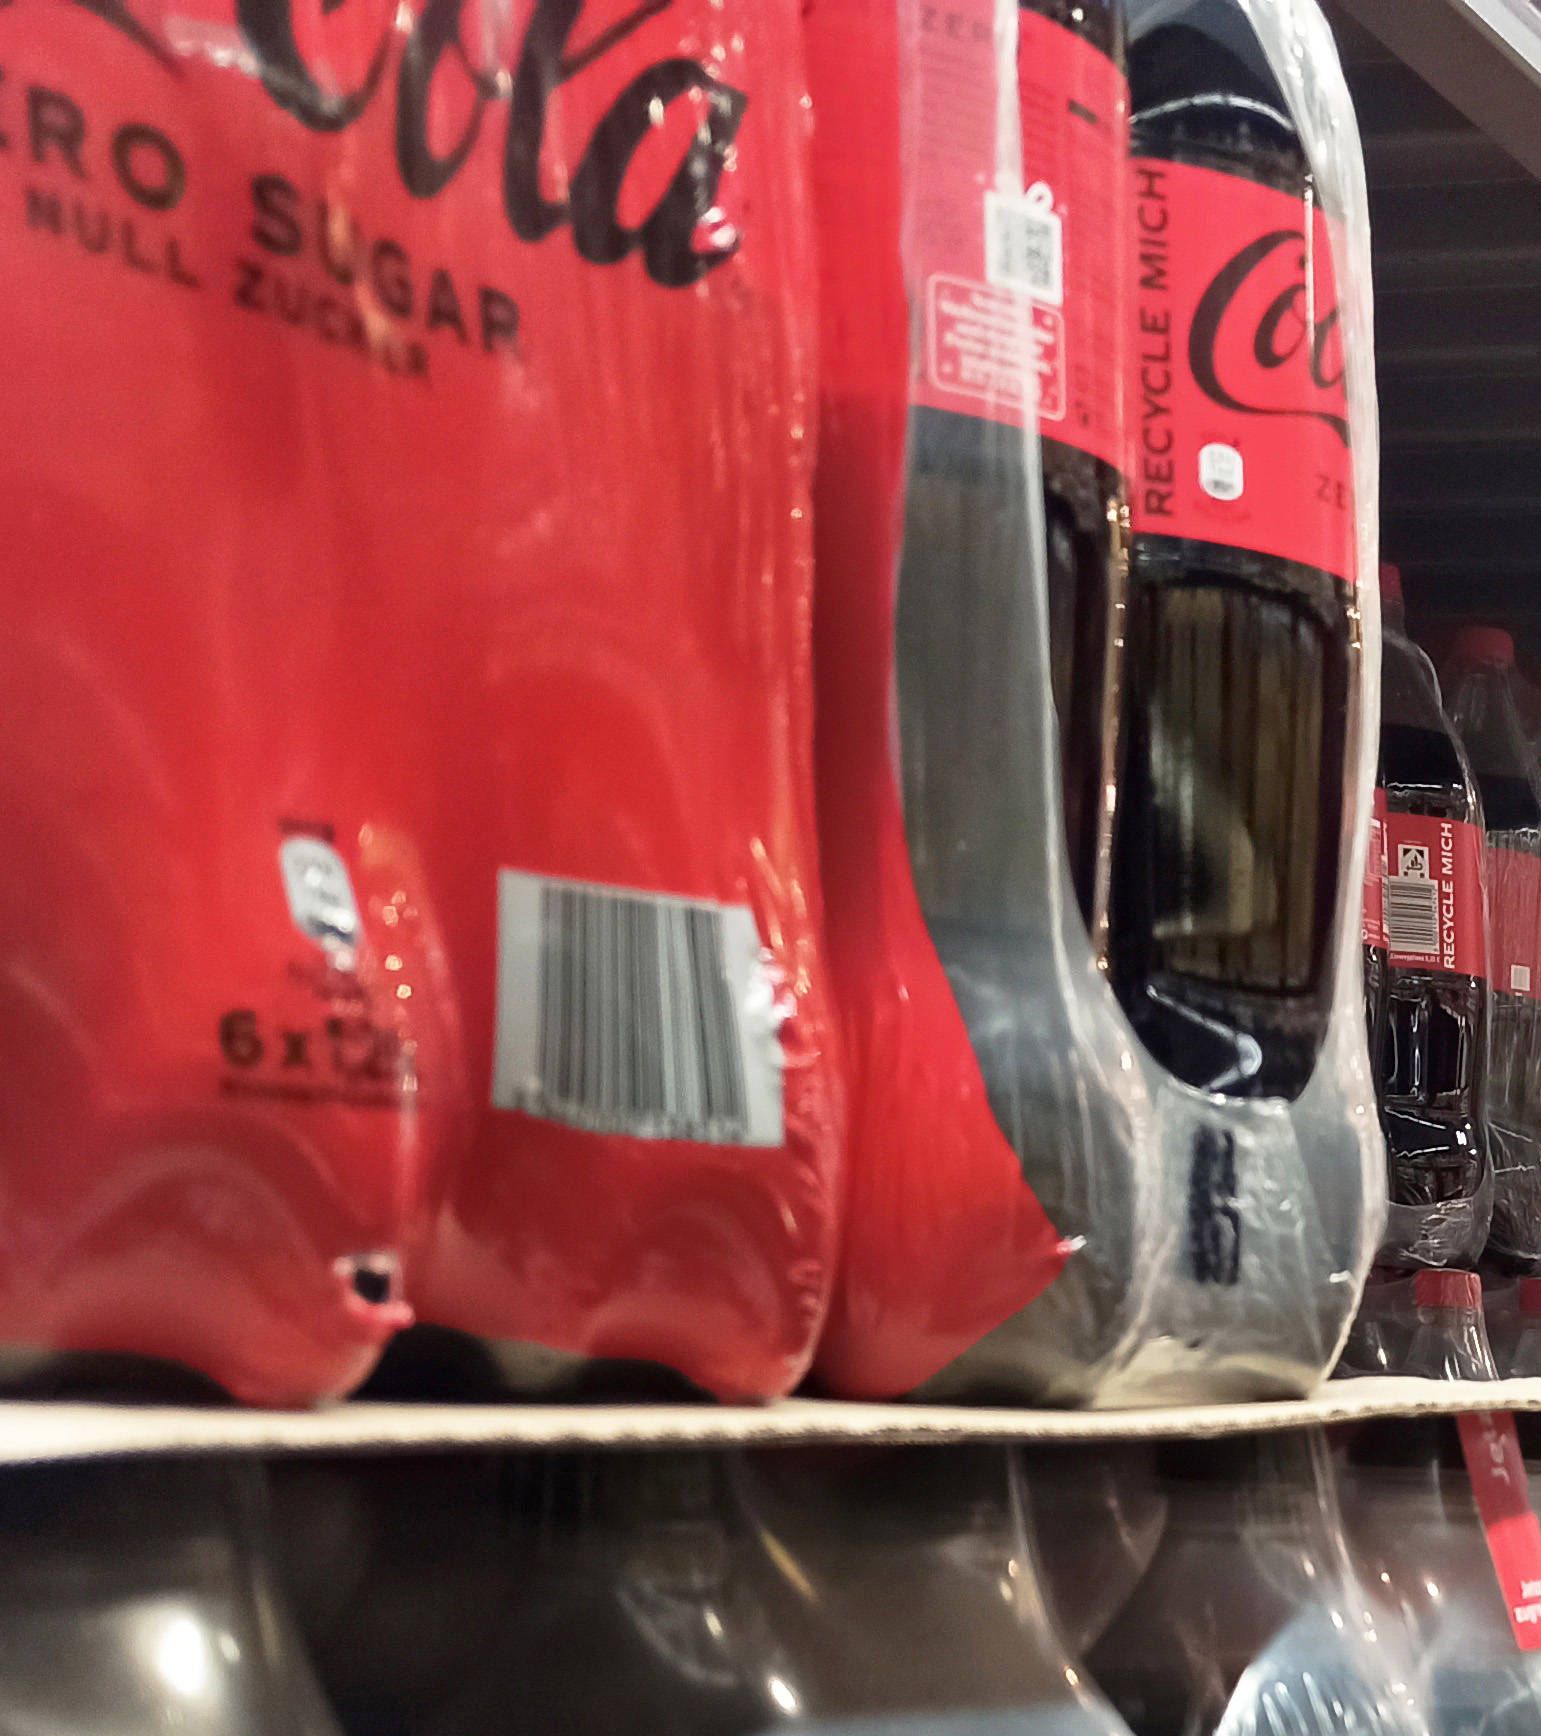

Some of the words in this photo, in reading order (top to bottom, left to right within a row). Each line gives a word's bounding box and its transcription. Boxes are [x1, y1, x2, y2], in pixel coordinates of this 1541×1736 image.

[24, 187, 201, 289] NULL
[249, 173, 521, 362] SUGAR
[1133, 166, 1170, 292] MICH
[1136, 306, 1174, 519] RECYCLE
[1440, 822, 1454, 876] MICH
[1441, 880, 1455, 969] RECYCLE
[218, 1009, 264, 1068] 6
